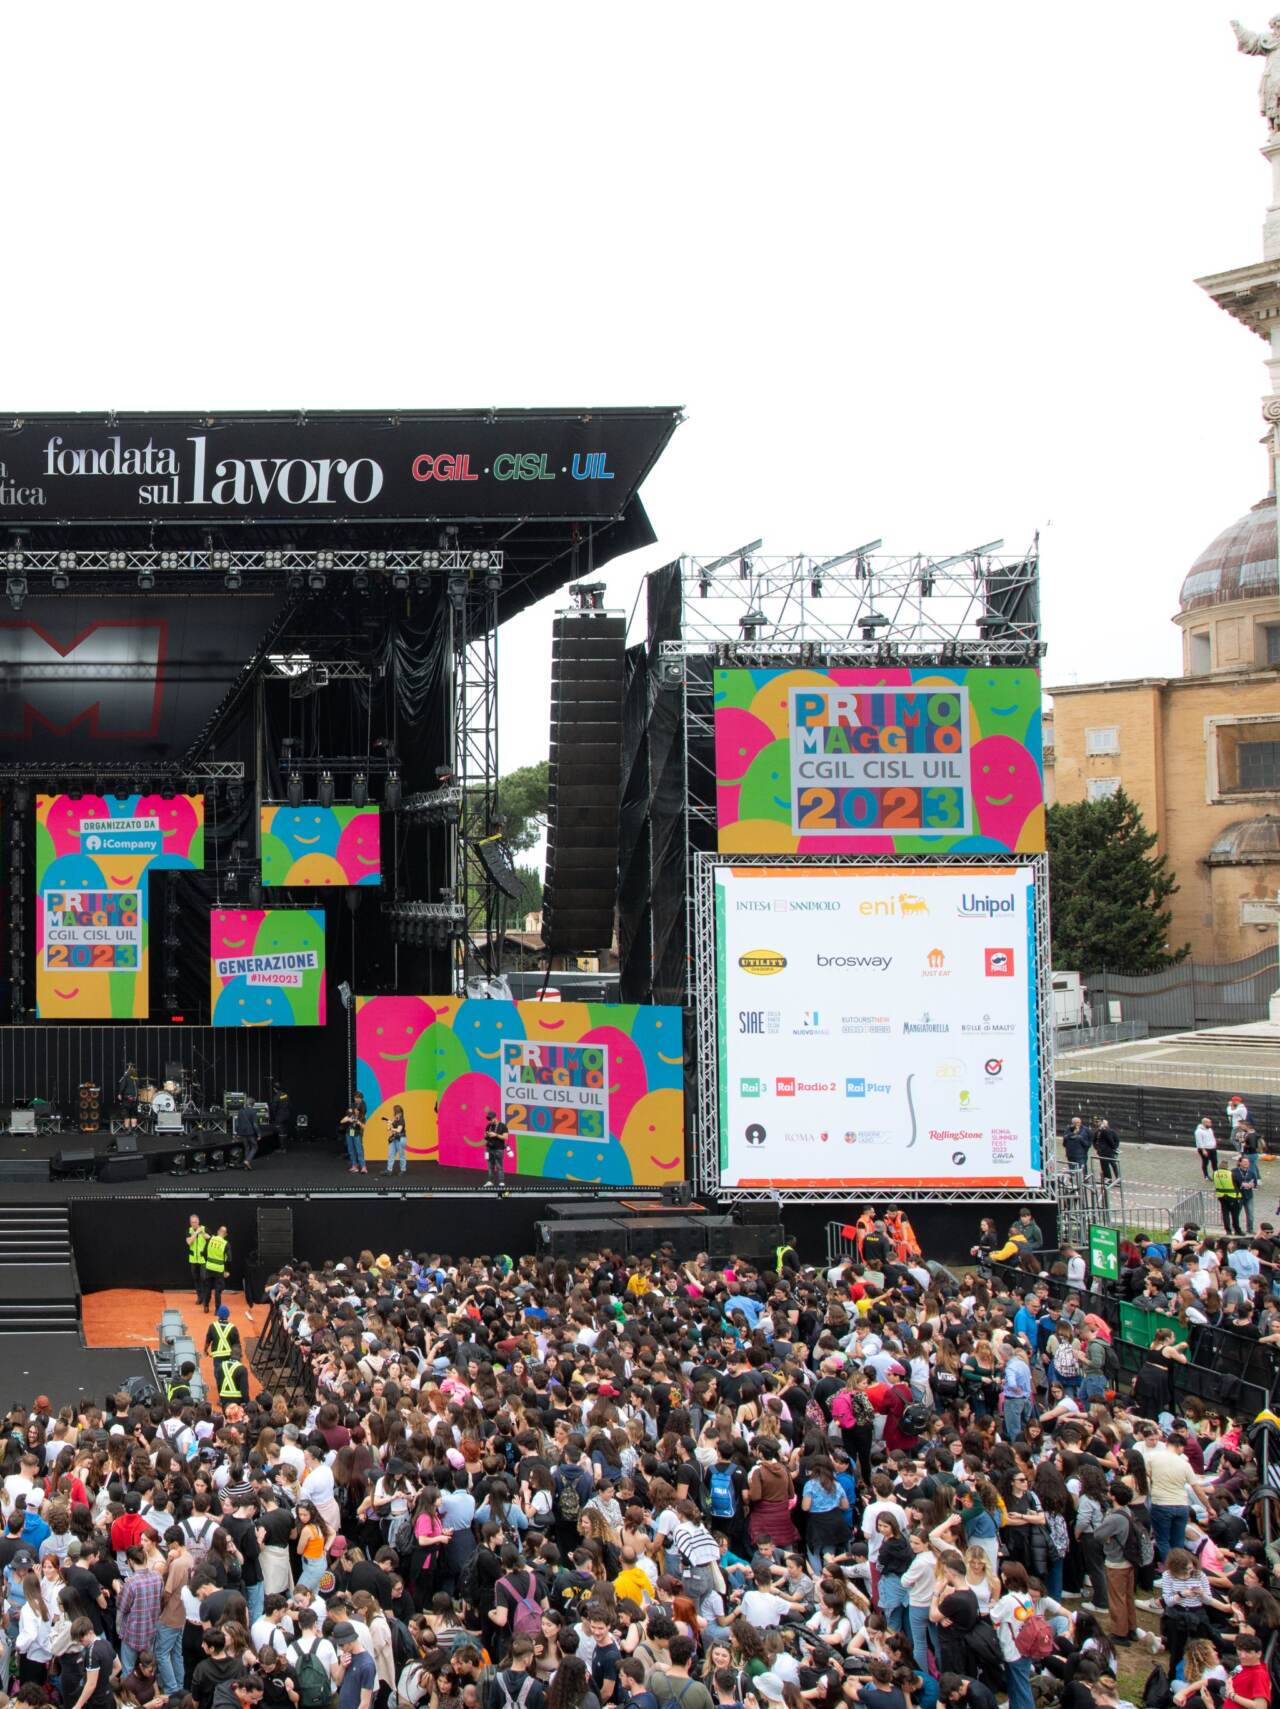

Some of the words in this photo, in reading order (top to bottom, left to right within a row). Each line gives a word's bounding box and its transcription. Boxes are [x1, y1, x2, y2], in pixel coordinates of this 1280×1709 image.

[42, 436, 180, 476] fondata
[186, 436, 384, 505] lavoro
[411, 453, 478, 482] CGIL
[493, 453, 556, 481] CISL
[571, 453, 615, 480] UIL
[138, 477, 180, 505] sul
[795, 693, 961, 727] PRIMO
[798, 725, 962, 754] MAGGIO
[798, 760, 855, 780] CGIL
[863, 760, 914, 779] CISL
[923, 760, 961, 779] UIL
[799, 787, 960, 829] 2023
[83, 820, 142, 831] ORGANIZZATO
[144, 819, 156, 830] DA
[102, 838, 157, 851] iCompany
[47, 893, 138, 912] PRIMO
[736, 901, 771, 911] INTESA
[858, 895, 896, 916] eni
[962, 893, 1015, 918] Unipol
[48, 911, 138, 927] MAGGIO
[48, 930, 79, 941] CGIL
[83, 930, 111, 941] CISL
[115, 930, 137, 941] UIL
[48, 945, 136, 967] 2023
[218, 953, 315, 975] GENERAZIONE
[817, 954, 893, 971] brosway
[739, 1011, 765, 1034] SIAE
[505, 1044, 604, 1071] PRIMO
[506, 1065, 604, 1088] MAGGIO
[777, 1082, 795, 1092] Rai
[797, 1082, 828, 1092] Radio
[830, 1083, 837, 1092] 2
[506, 1087, 538, 1100] CGIL
[543, 1090, 574, 1103] CISL
[579, 1092, 603, 1105] UIL
[741, 1083, 759, 1093] Rai
[847, 1083, 864, 1093] Rai
[867, 1082, 892, 1095] Play
[506, 1104, 602, 1138] 2023
[928, 1130, 984, 1141] RollingStone
